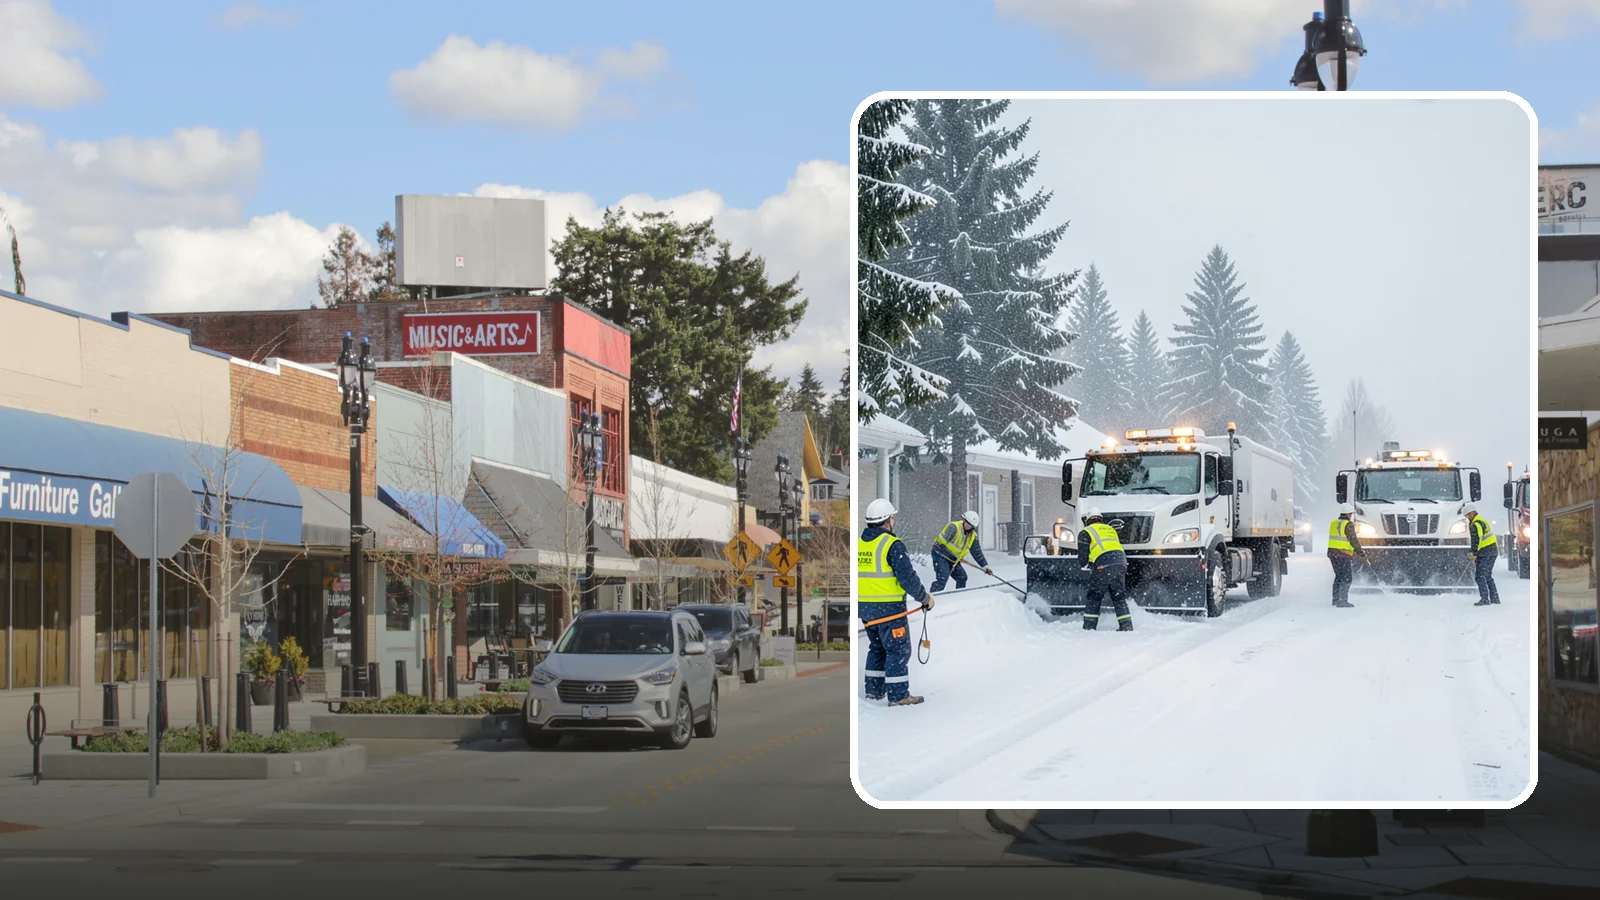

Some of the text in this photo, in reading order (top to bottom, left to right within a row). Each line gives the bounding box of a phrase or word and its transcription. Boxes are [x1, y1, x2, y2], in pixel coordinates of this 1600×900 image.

[409, 323, 520, 348] MUSIC&ARTS
[0, 472, 79, 515] Furniture
[453, 563, 479, 574] SUSHI
